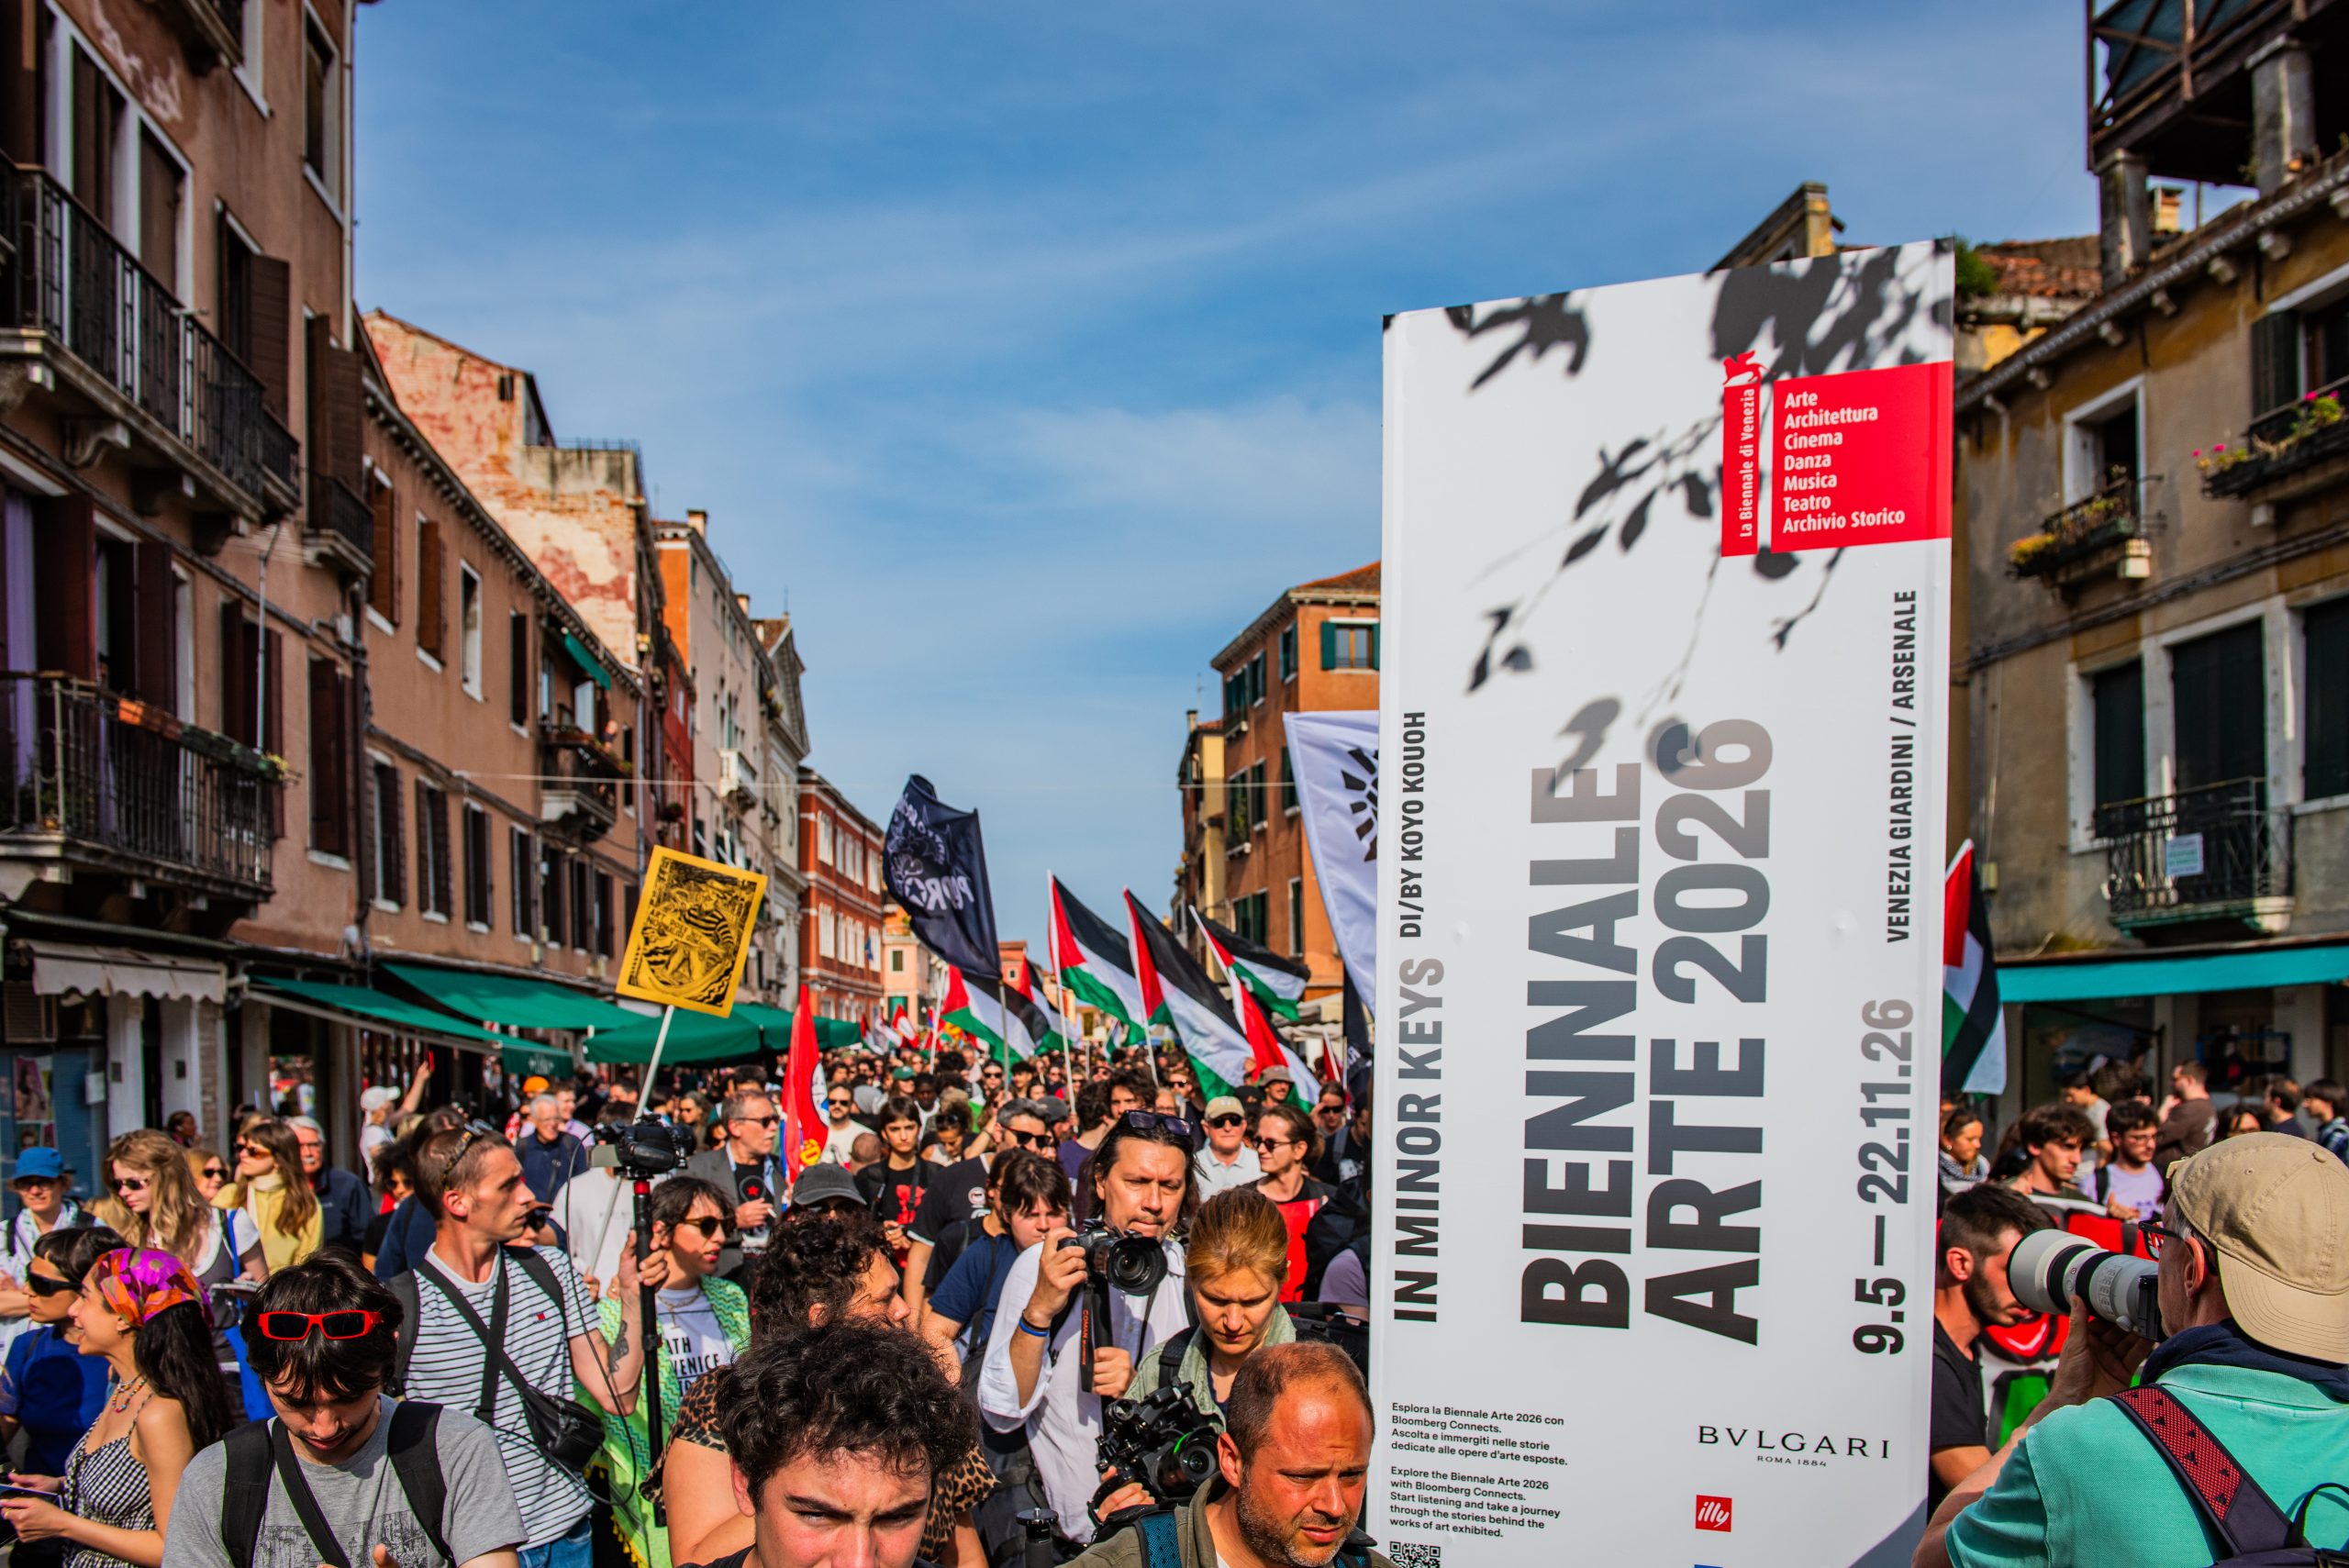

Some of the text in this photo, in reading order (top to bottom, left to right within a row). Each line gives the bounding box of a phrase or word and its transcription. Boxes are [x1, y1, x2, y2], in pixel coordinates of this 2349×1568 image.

[1785, 391, 1818, 408] Arte
[1784, 407, 1878, 429] Architettura
[1784, 432, 1842, 450] Cinema
[1739, 389, 1754, 537] La Biennale di Venezia
[1784, 454, 1831, 471] Danza
[1784, 472, 1837, 492] Musica
[1783, 495, 1831, 512] Teatro
[1783, 507, 1905, 533] Archivio Storico
[1892, 590, 1917, 710] ARSENALE
[1889, 735, 1913, 840] GIARDINI
[1398, 712, 1426, 938] DI/BY KOYO KOUOH
[1887, 844, 1911, 943] VENEZIA
[1644, 718, 1773, 1346] ARTE 2026
[1520, 762, 1641, 1329] BIENNALE
[1394, 958, 1444, 1322] IN MINOR KEYS
[1392, 1402, 1430, 1414] Esplora
[1432, 1406, 1441, 1415] la
[1444, 1407, 1488, 1418] Biennale
[1490, 1411, 1513, 1421] Arte
[1516, 1413, 1542, 1423] 2026
[1392, 1415, 1501, 1433] Bloomberg Connects.
[1392, 1429, 1430, 1440] Ascolta
[1441, 1434, 1489, 1446] immergiti
[1492, 1439, 1517, 1448] nelle
[1520, 1440, 1550, 1451] storie
[1698, 1426, 1890, 1459] BVLGARI
[1391, 1441, 1567, 1465] dedicate alle opere d'arte esposte.
[1757, 1455, 1827, 1467] ROMA 1884
[1390, 1480, 1526, 1500] with Bloomberg Connects.
[1391, 1466, 1549, 1490] Explore the Biennale Arte 2026
[1390, 1491, 1415, 1502] Start
[1418, 1495, 1462, 1509] listening
[1464, 1501, 1484, 1509] and
[1486, 1502, 1509, 1512] take
[1520, 1505, 1561, 1518] journey
[1698, 1501, 1730, 1528] illy
[1389, 1519, 1420, 1529] works
[1422, 1521, 1432, 1529] of
[1452, 1525, 1503, 1538] exhibited.
[1390, 1505, 1544, 1529] through the stories behind the
